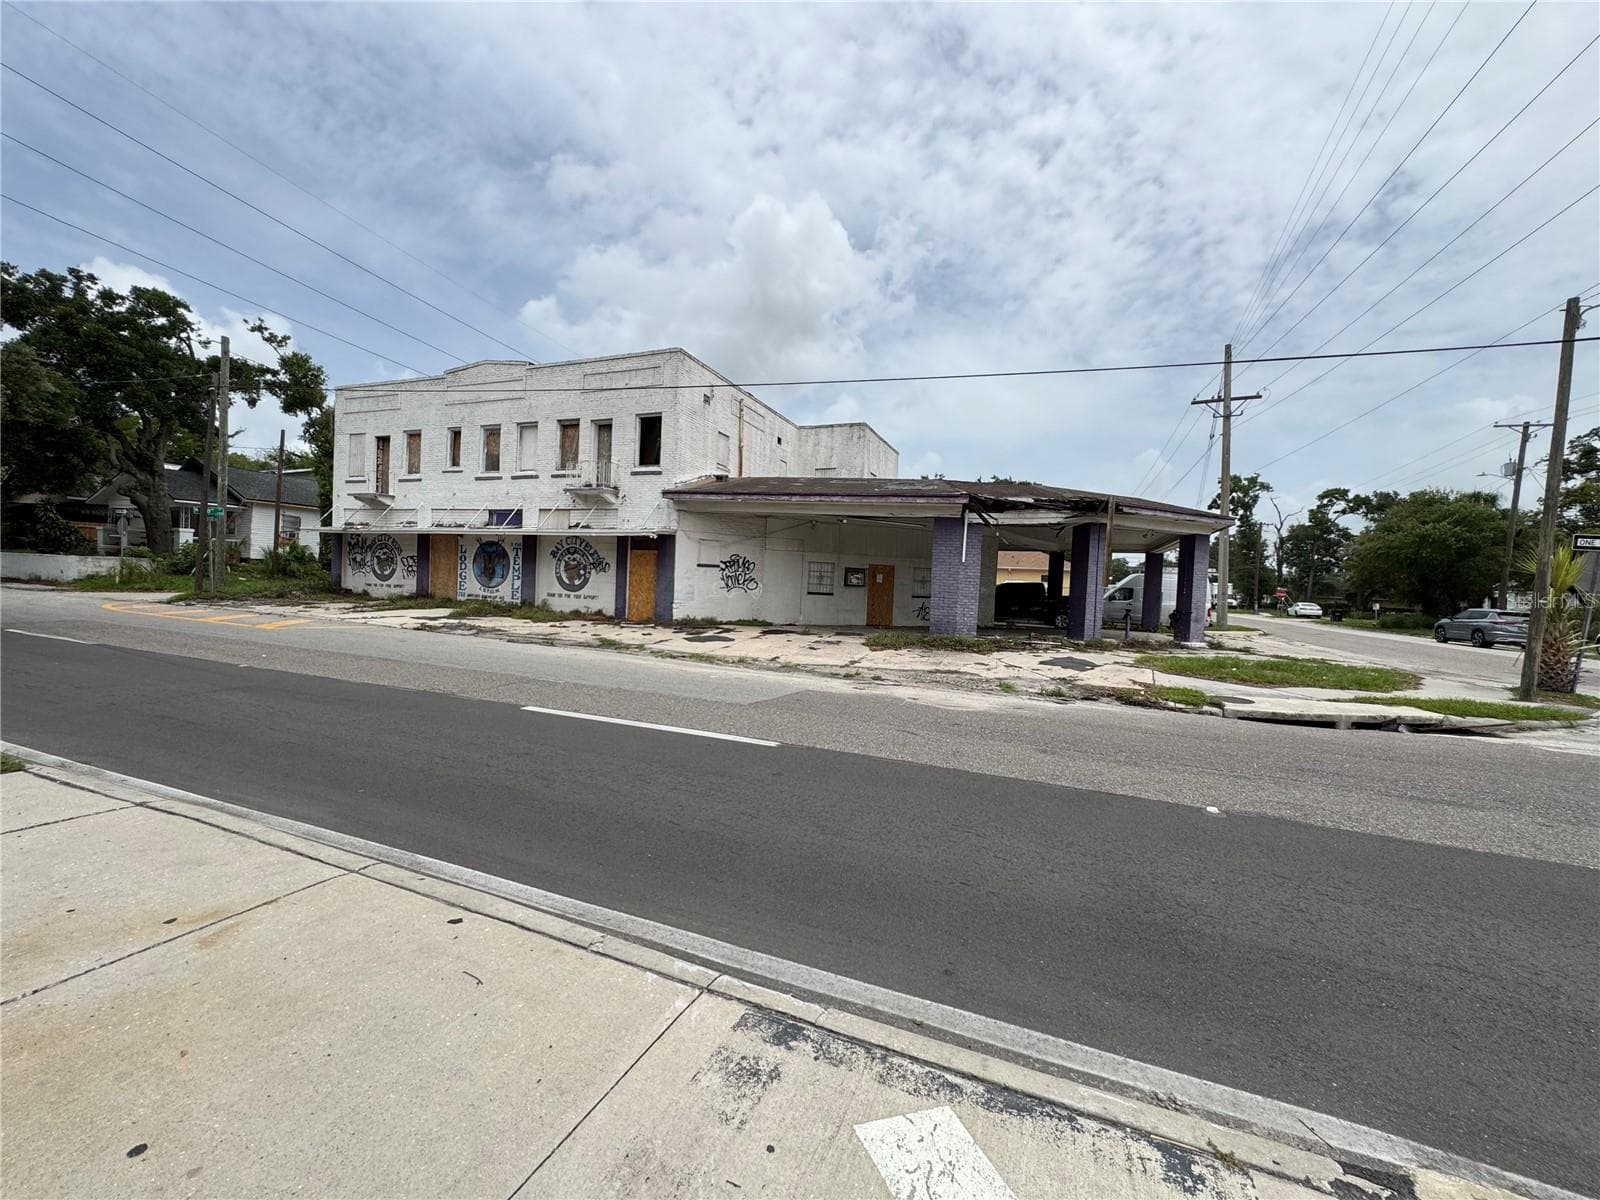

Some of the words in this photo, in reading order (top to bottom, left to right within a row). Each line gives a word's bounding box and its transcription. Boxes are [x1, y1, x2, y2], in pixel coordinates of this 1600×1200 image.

[458, 544, 467, 591] LODGE
[550, 539, 565, 559] BAY
[565, 535, 586, 550] CITY
[511, 547, 521, 600] TEMPLE
